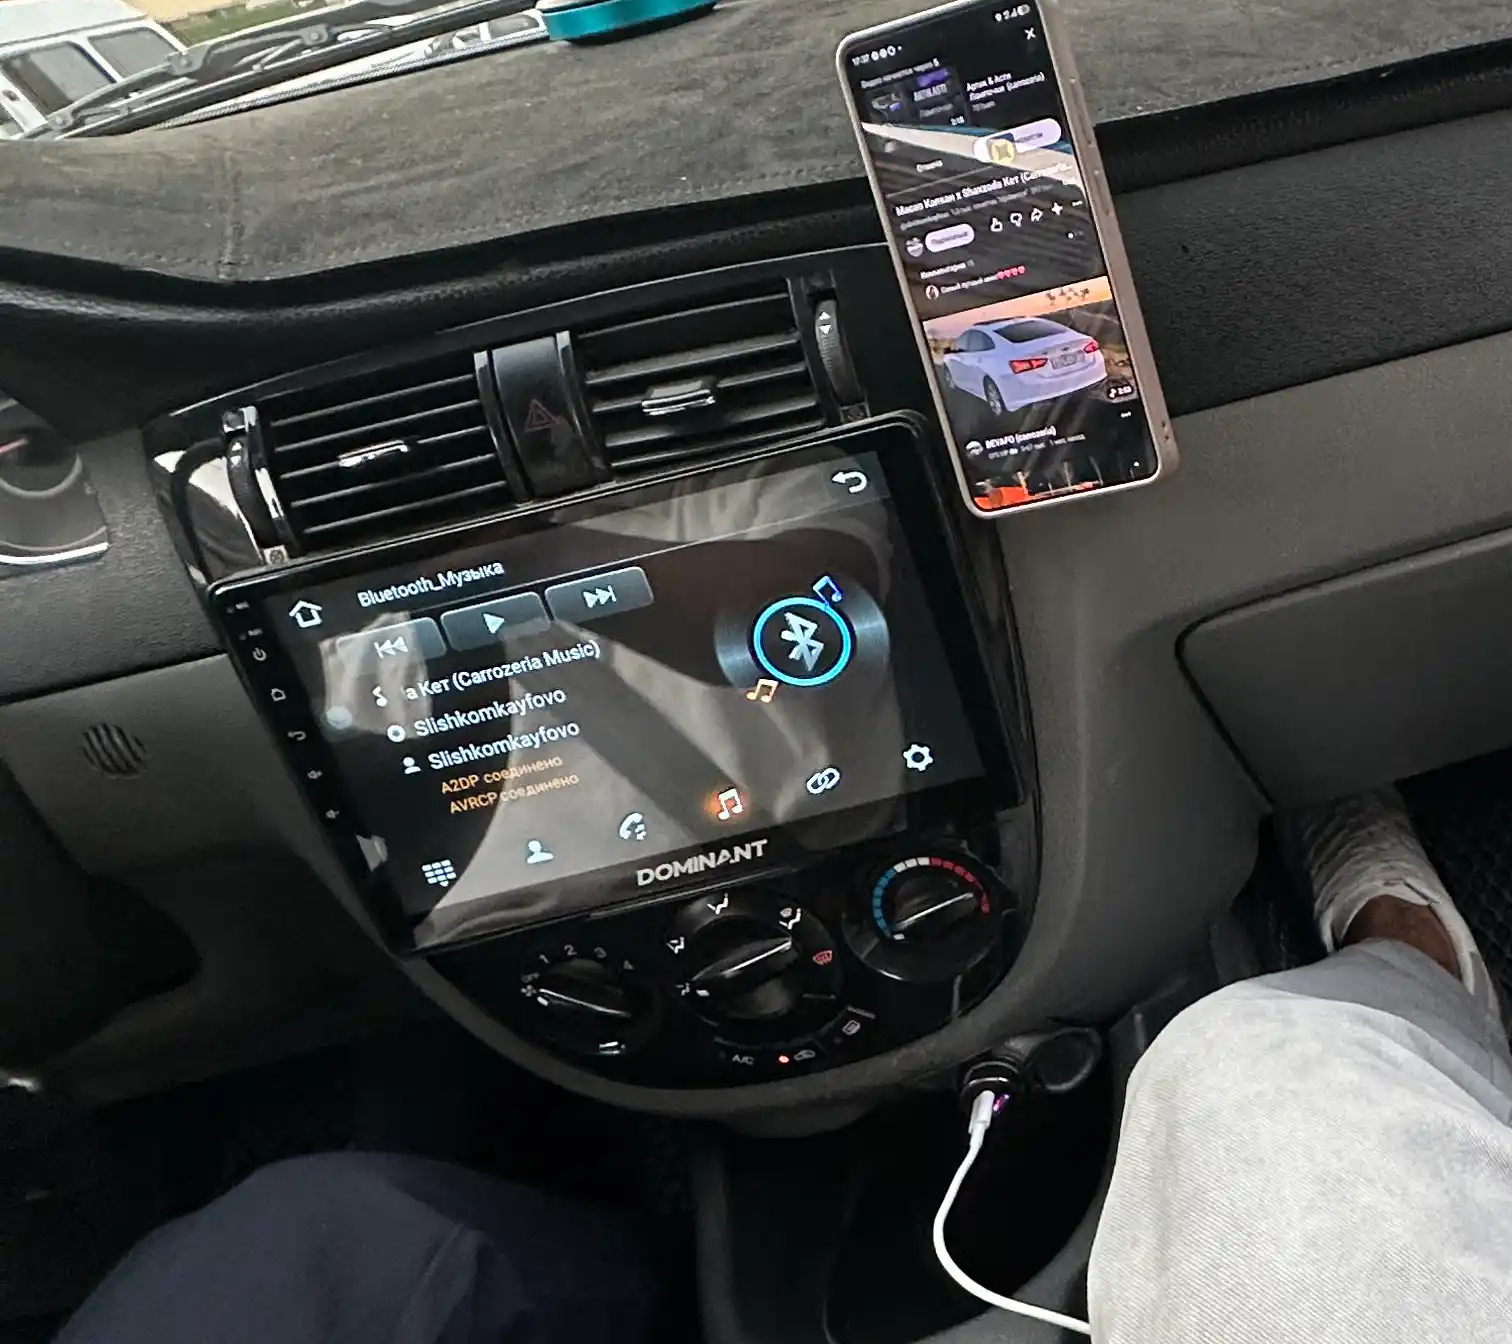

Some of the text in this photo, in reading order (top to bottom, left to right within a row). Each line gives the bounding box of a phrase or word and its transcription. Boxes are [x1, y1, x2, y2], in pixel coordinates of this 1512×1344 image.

[542, 639, 601, 670] Music)
[414, 689, 567, 737] Slishkomkayfovo
[427, 722, 581, 770] Slishkomkayfovo
[441, 773, 480, 794] A2DP
[449, 791, 498, 814] AVRCP
[636, 838, 768, 886] DOMINANT
[563, 944, 577, 956] 2
[594, 946, 607, 958] 3
